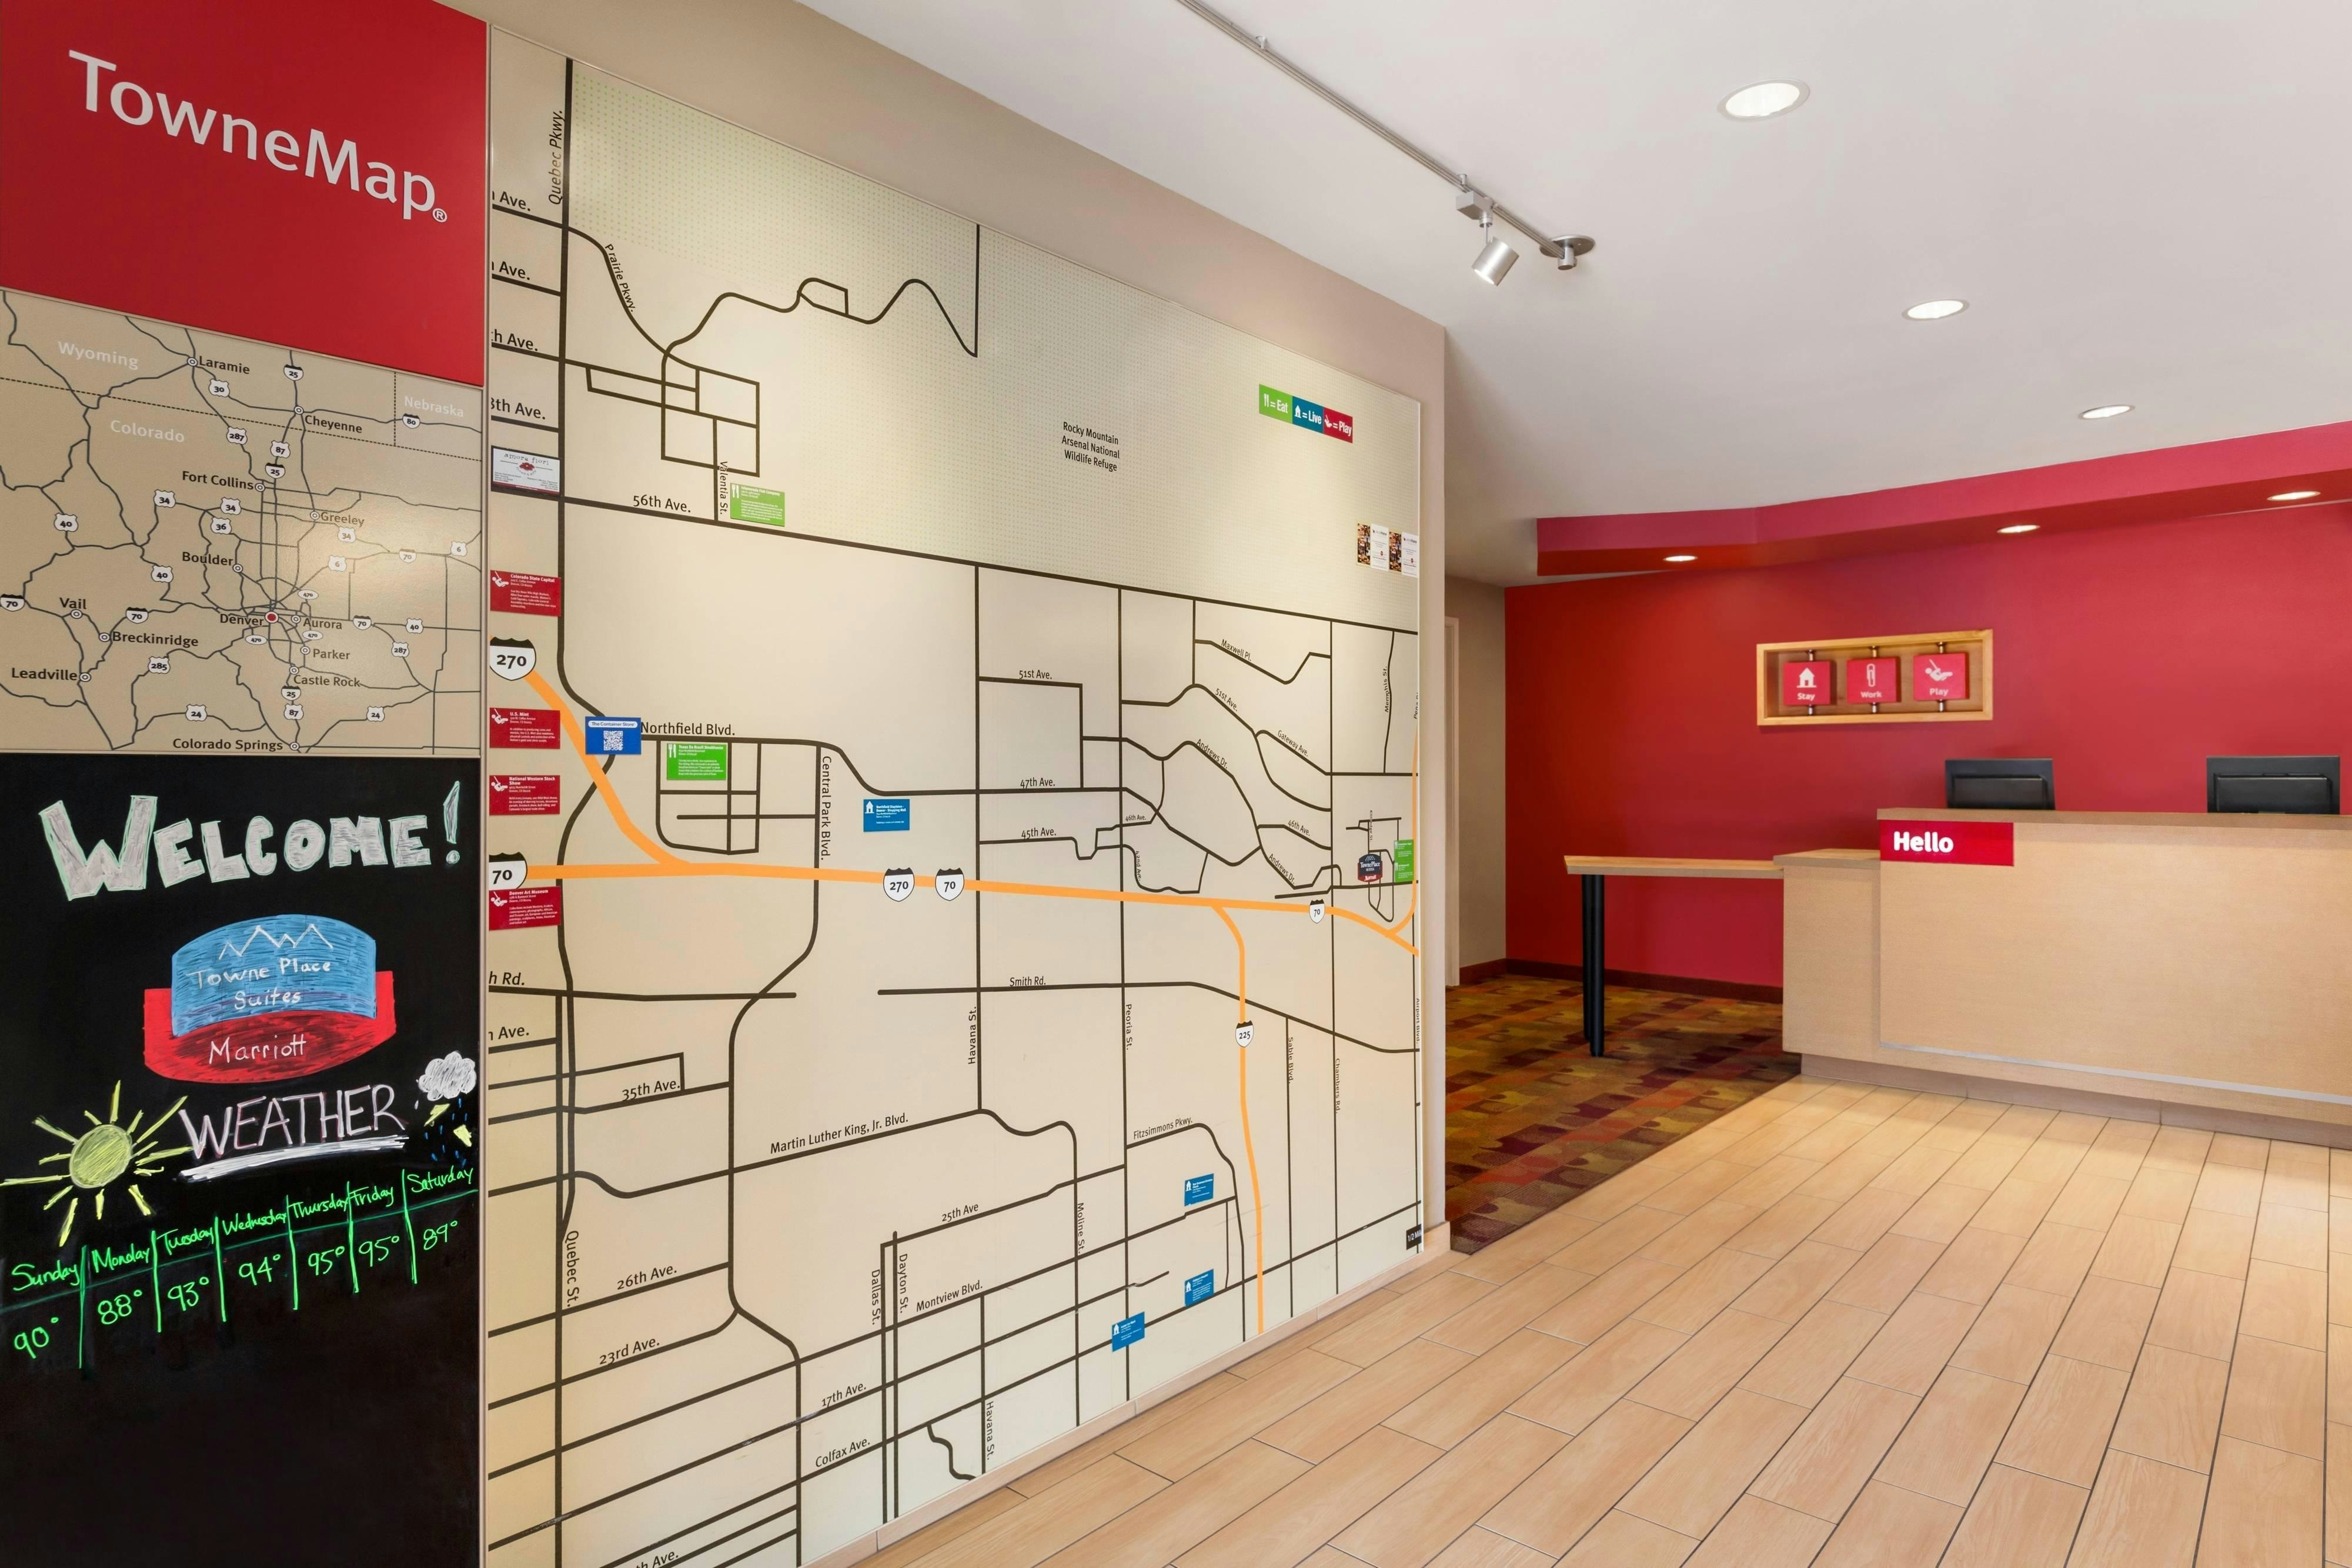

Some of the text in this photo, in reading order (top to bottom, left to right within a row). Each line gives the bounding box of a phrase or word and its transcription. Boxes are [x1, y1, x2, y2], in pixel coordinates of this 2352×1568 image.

[548, 110, 565, 205] Quebec Pkwy.
[499, 190, 531, 212] Ave.
[604, 243, 636, 312] Prairie Pkwy.
[507, 333, 538, 351] Ave.
[58, 341, 139, 370] Wyoming
[199, 356, 250, 375] Laramie
[404, 396, 464, 417] Nebraska
[515, 402, 546, 420] Ave.
[1277, 399, 1288, 413] Eat
[305, 415, 362, 433] Cheyenne
[1308, 410, 1322, 424] Live
[111, 420, 185, 443] Colorado
[229, 433, 245, 442] 287
[1063, 421, 1118, 445] Rocky Mountain
[1339, 421, 1352, 436] Play
[1061, 435, 1120, 459] Arsenal National
[1064, 449, 1117, 472] Wildlife Refuge
[182, 471, 253, 490] Fort Collins
[719, 461, 729, 515] Valentia St.
[633, 494, 691, 513] 56th Ave.
[320, 511, 365, 527] Greeley
[182, 551, 233, 566] Boulder
[59, 597, 86, 610] Vail
[220, 613, 264, 627] Denver
[303, 619, 342, 630] Aurora
[112, 631, 199, 648] Breckinridge
[1221, 639, 1244, 657] Maxwell
[313, 648, 350, 660] Parker
[496, 654, 527, 669] 270
[11, 667, 78, 681] Leadville
[151, 663, 168, 671] 285
[1019, 670, 1053, 680] 51st Ave.
[293, 674, 360, 688] Castle Rock
[1797, 692, 1816, 701] Stay
[1860, 690, 1882, 698] Work
[1929, 687, 1949, 697] Play
[641, 721, 736, 735] Northfield Blvd.
[173, 738, 283, 752] Colorado Springs
[1197, 738, 1220, 762] Andrews
[1020, 777, 1055, 790] 47th Ave.
[821, 755, 832, 860] Central Park Blvd.
[38, 780, 461, 901] WELCOME!
[1021, 827, 1057, 840] 45th Ave.
[1893, 831, 1954, 853] Hello
[492, 870, 512, 884] 70
[890, 881, 909, 892] 270
[944, 881, 956, 892] 70
[1314, 908, 1321, 917] 70
[186, 957, 332, 990] Towne Place
[502, 972, 525, 985] Rd.
[1009, 976, 1046, 987] Smith Rd.
[234, 989, 302, 1011] Suites
[498, 1025, 530, 1039] Ave.
[968, 1006, 977, 1064] Havana St.
[1239, 1031, 1251, 1039] 225
[208, 1033, 308, 1065] Marriott
[622, 1078, 681, 1101] 35th Ave.
[178, 1084, 408, 1159] WEATHER
[1134, 1117, 1193, 1139] Fitzsimmons Pkwy.
[770, 1112, 908, 1154] Martin Luther King, Jr. Blvd.
[942, 1203, 979, 1223] 25th Ave
[11, 1262, 81, 1292] Sunday
[91, 1242, 151, 1275] Monday
[156, 1222, 215, 1258] Tuesday
[288, 1192, 350, 1220] Thursday
[349, 1183, 395, 1208] Friday
[407, 1165, 475, 1196] Saturday
[565, 1230, 580, 1308] Quebec St.
[616, 1265, 677, 1290] 26th Ave.
[897, 1253, 908, 1313] Dayton St.
[871, 1269, 881, 1325] Dallas St.
[916, 1279, 983, 1312] Montview Blvd.
[599, 1337, 660, 1365] 23rd Ave.
[821, 1383, 866, 1407] 17th Ave.
[815, 1438, 870, 1468] Colfax Ave.
